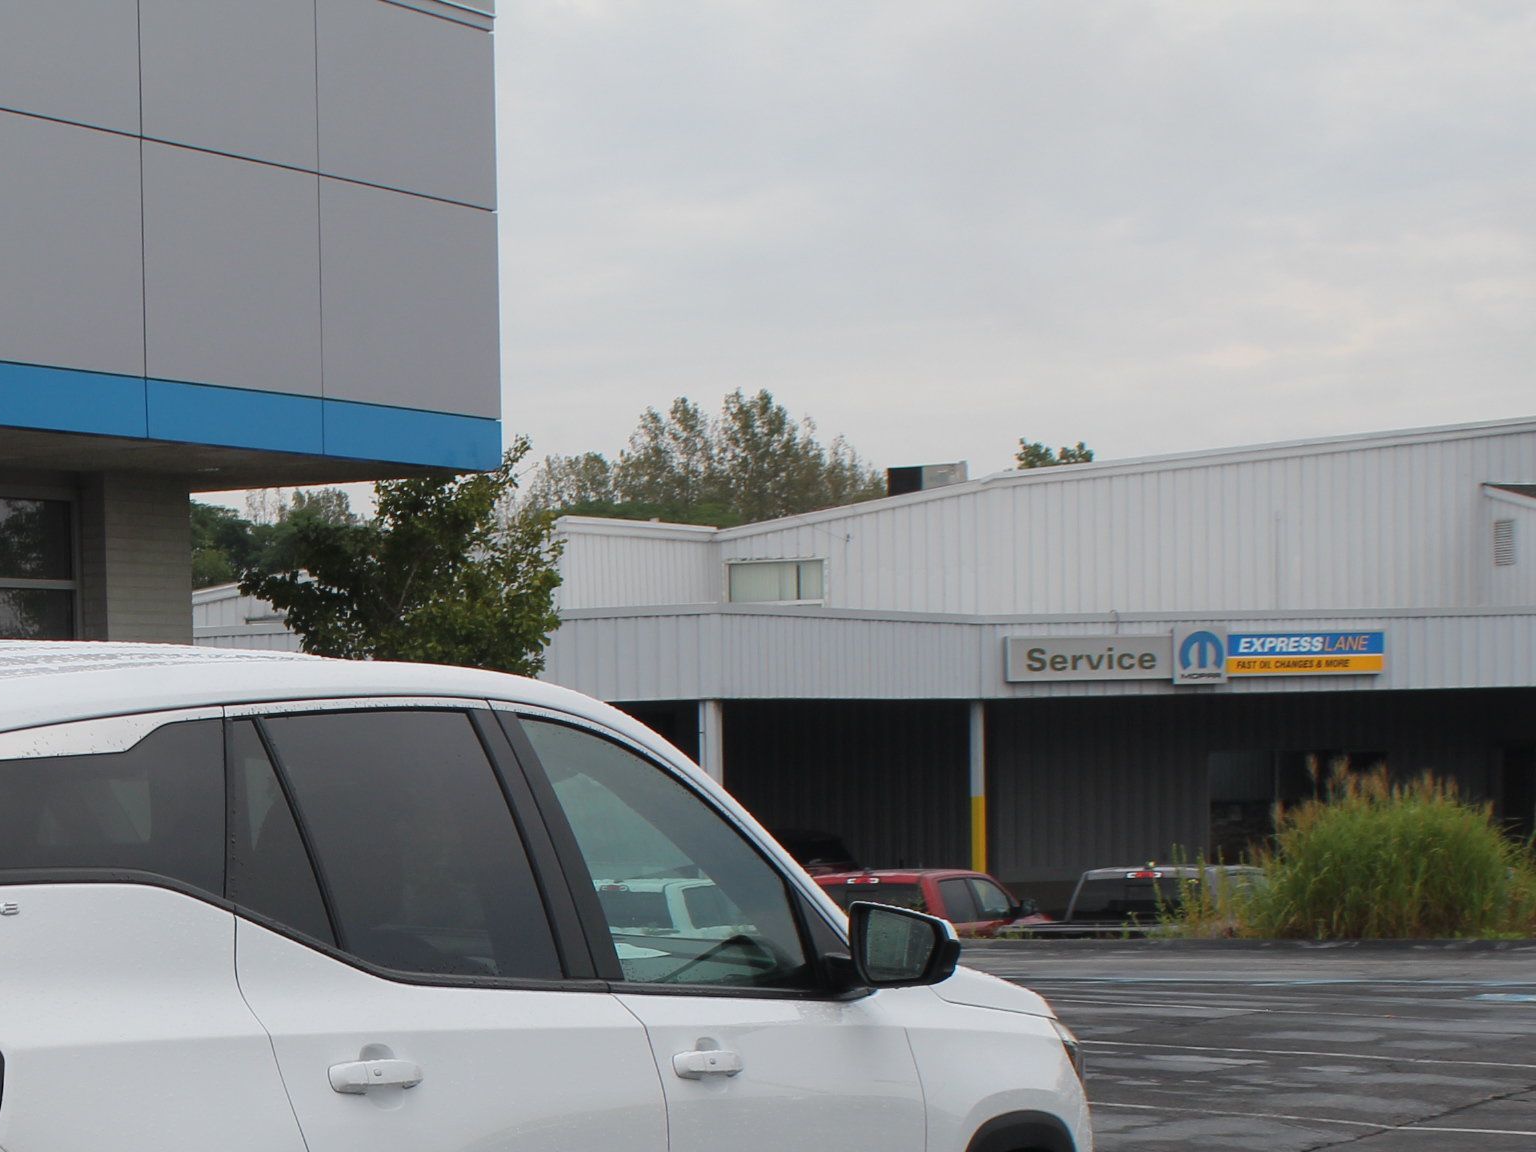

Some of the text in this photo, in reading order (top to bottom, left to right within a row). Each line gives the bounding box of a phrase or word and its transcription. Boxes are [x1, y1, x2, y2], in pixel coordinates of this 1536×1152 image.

[1026, 647, 1157, 671] Service
[1236, 660, 1257, 669] FAST
[1260, 660, 1272, 669] OIL
[1275, 659, 1314, 669] CHANGES
[1325, 659, 1350, 668] MORE
